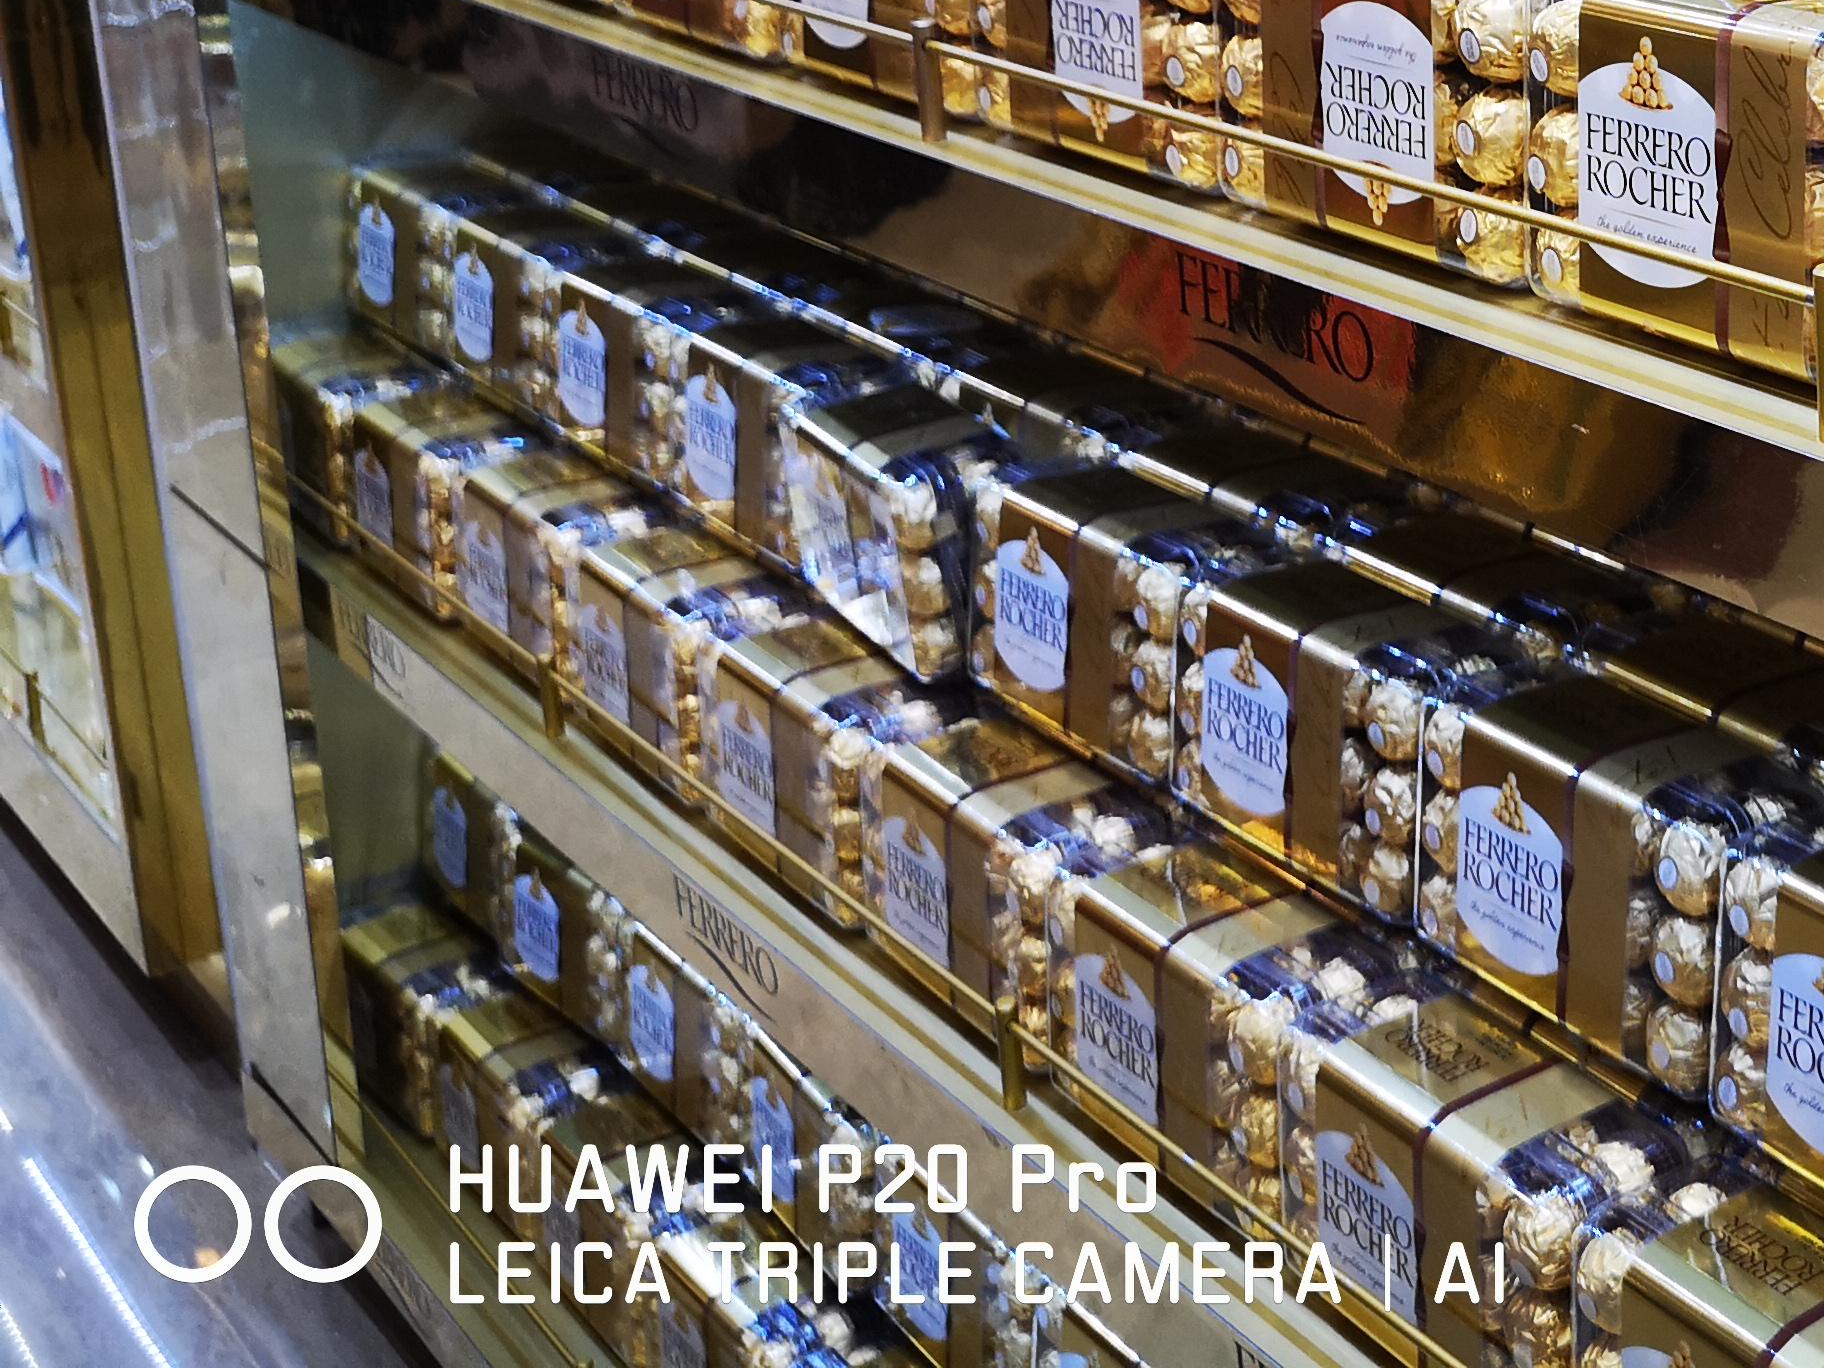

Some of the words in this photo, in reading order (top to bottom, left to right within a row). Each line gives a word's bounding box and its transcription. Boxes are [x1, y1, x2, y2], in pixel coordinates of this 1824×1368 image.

[1057, 38, 1137, 82] FERRERO
[1325, 61, 1426, 120] ROCHER
[1326, 102, 1426, 160] FERRERO
[1586, 112, 1710, 177] FERRERO
[1586, 154, 1712, 224] ROCHER
[1176, 251, 1374, 381] FERRERO
[1000, 568, 1065, 621] FERRERO
[1001, 600, 1063, 651] ROCHER
[1207, 678, 1284, 739] FERRERO
[1207, 708, 1282, 774] ROCHER
[1464, 817, 1559, 892] FERRERO
[1464, 851, 1557, 930] ROCHER
[672, 871, 778, 995] FERRERO
[1079, 980, 1154, 1053] FERRERO
[1080, 1013, 1154, 1089] ROCHER
[1322, 1162, 1412, 1247] FERRERO
[1323, 1191, 1414, 1288] ROCHER
